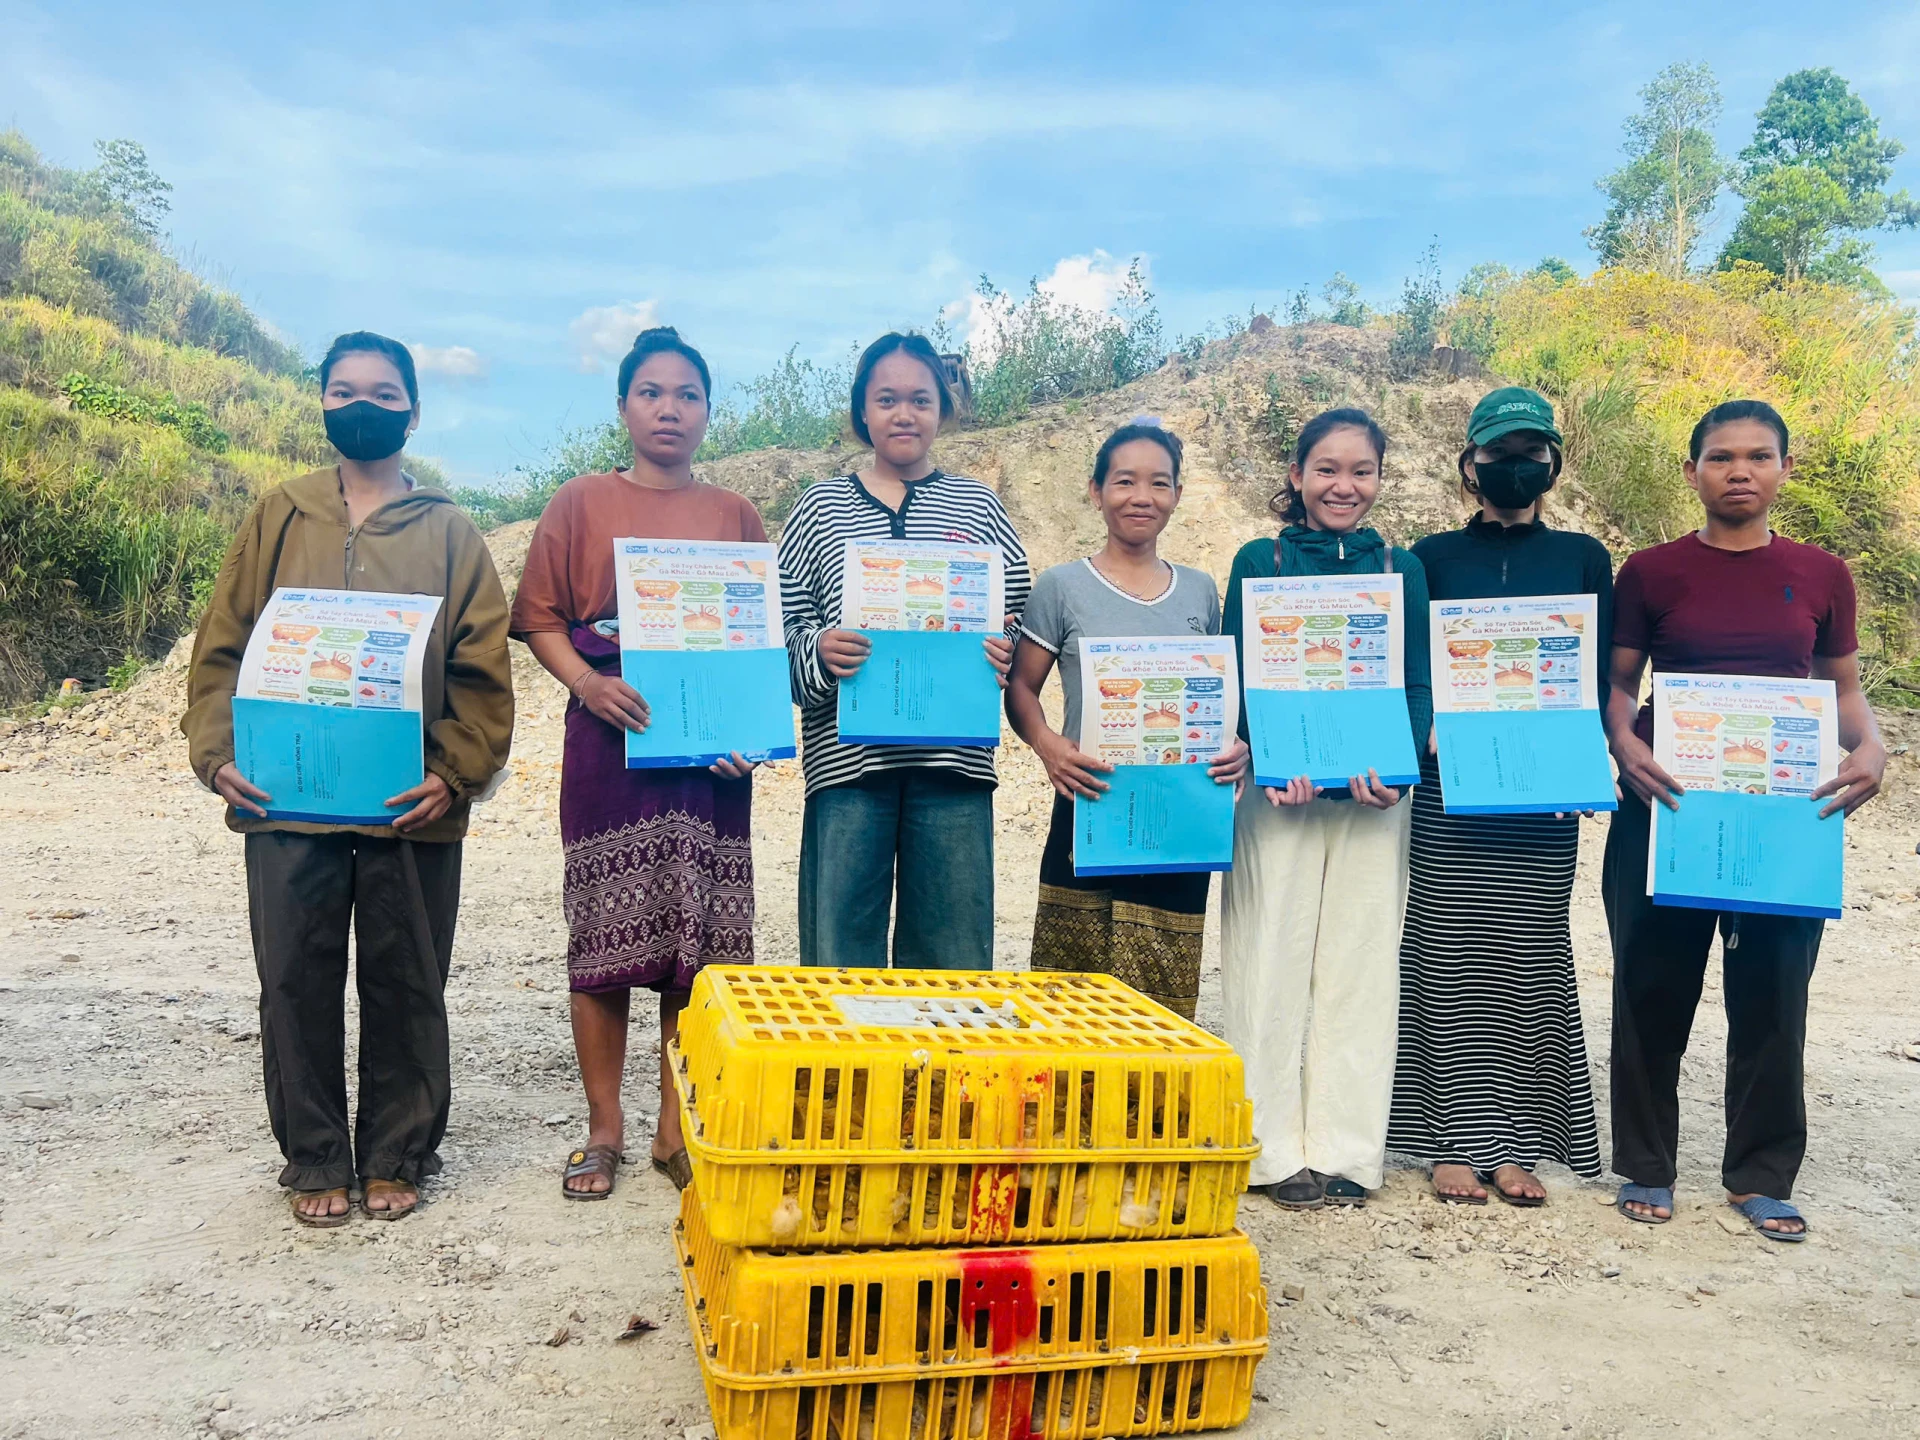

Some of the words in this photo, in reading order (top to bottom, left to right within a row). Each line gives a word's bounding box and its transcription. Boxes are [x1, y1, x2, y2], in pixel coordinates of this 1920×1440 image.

[653, 546, 682, 554] KOICA
[1279, 583, 1307, 591] KOICA
[1116, 644, 1143, 652] KOICA
[1694, 680, 1726, 688] KOICA
